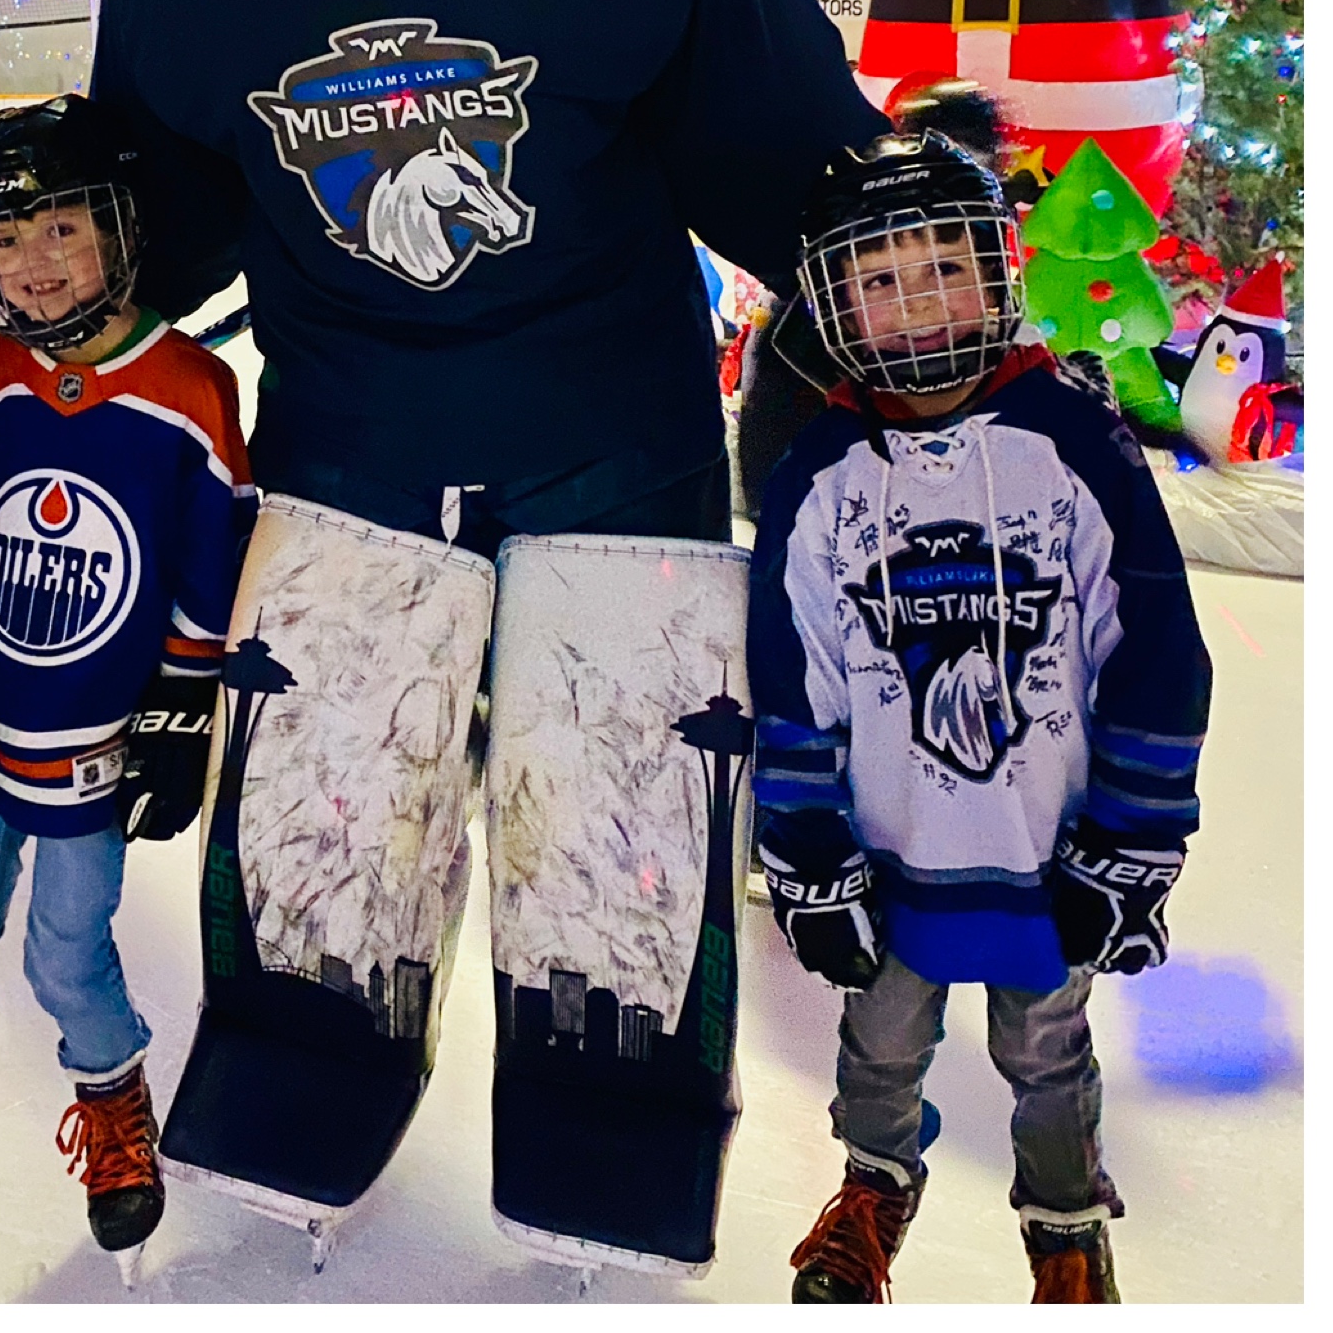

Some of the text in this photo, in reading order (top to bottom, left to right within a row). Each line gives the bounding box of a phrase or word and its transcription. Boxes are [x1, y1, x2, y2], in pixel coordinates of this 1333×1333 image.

[325, 66, 457, 96] WILLIAMS LAKE
[269, 71, 520, 151] MUSTANGS
